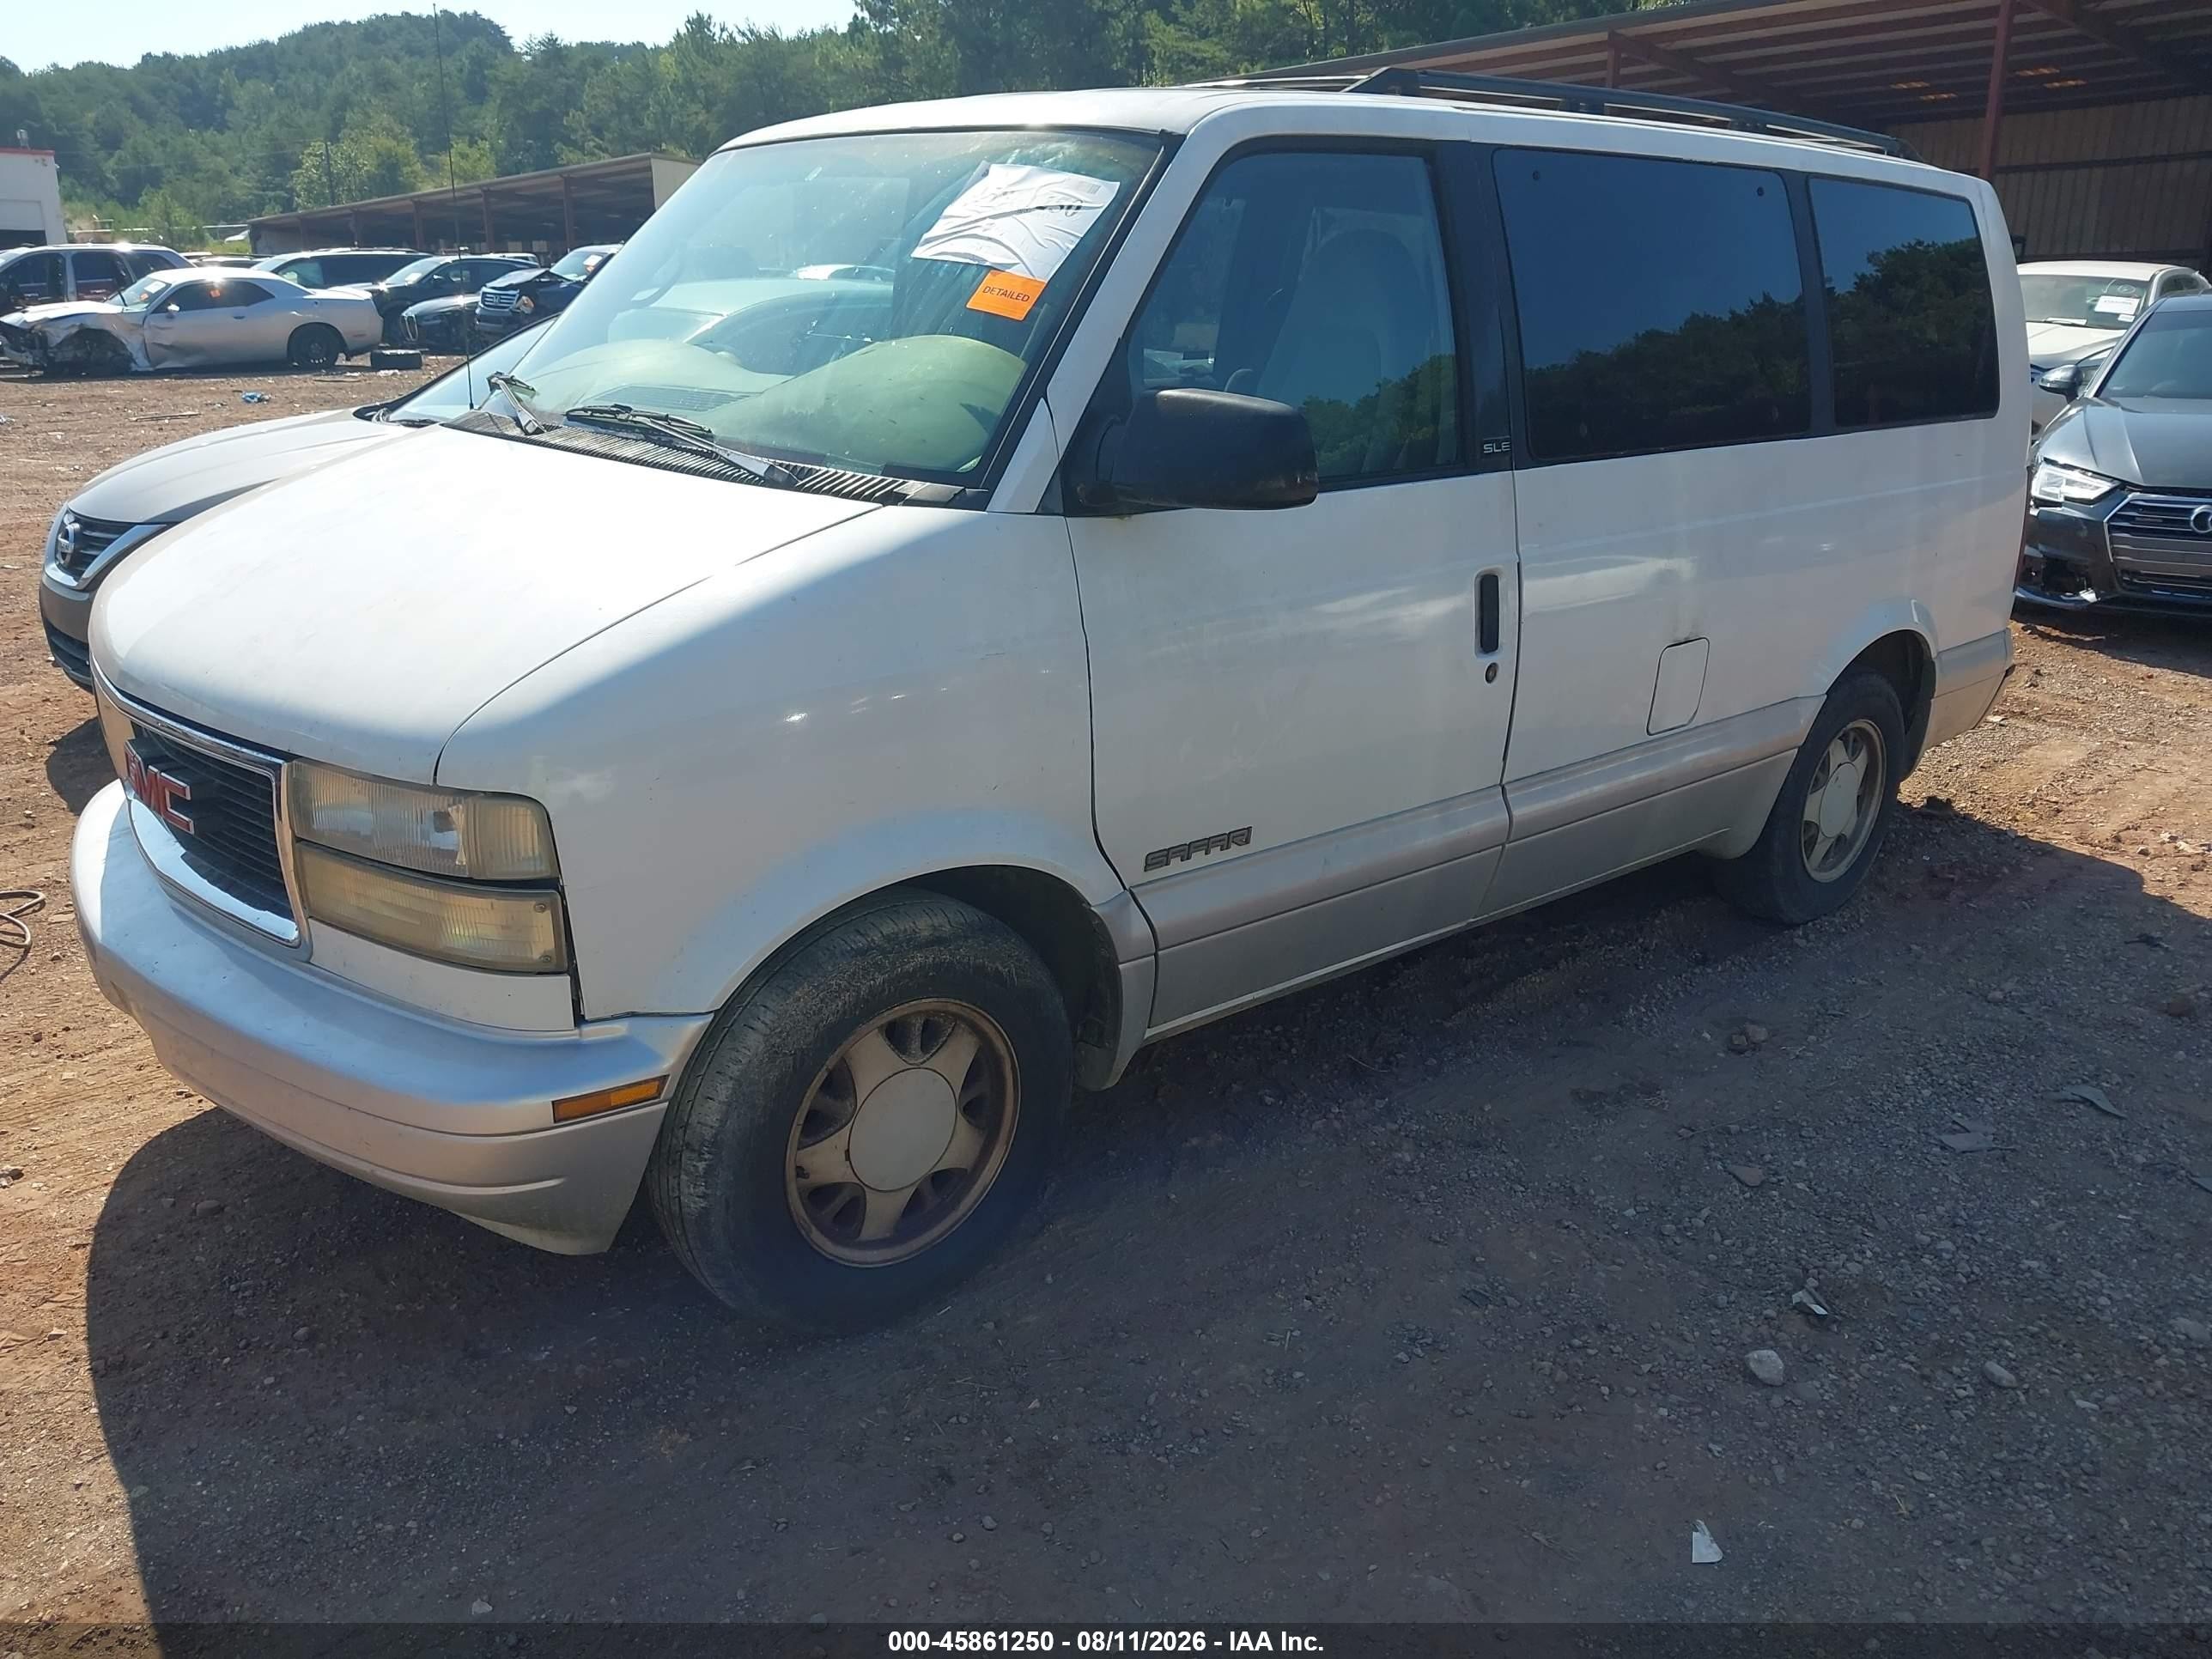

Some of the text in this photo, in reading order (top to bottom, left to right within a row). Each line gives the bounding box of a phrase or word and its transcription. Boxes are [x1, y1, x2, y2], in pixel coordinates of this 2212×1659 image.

[982, 286, 1030, 302] DETAILED
[1483, 441, 1511, 453] SLE
[125, 740, 195, 835] GMC
[1144, 826, 1253, 872] SAFARI
